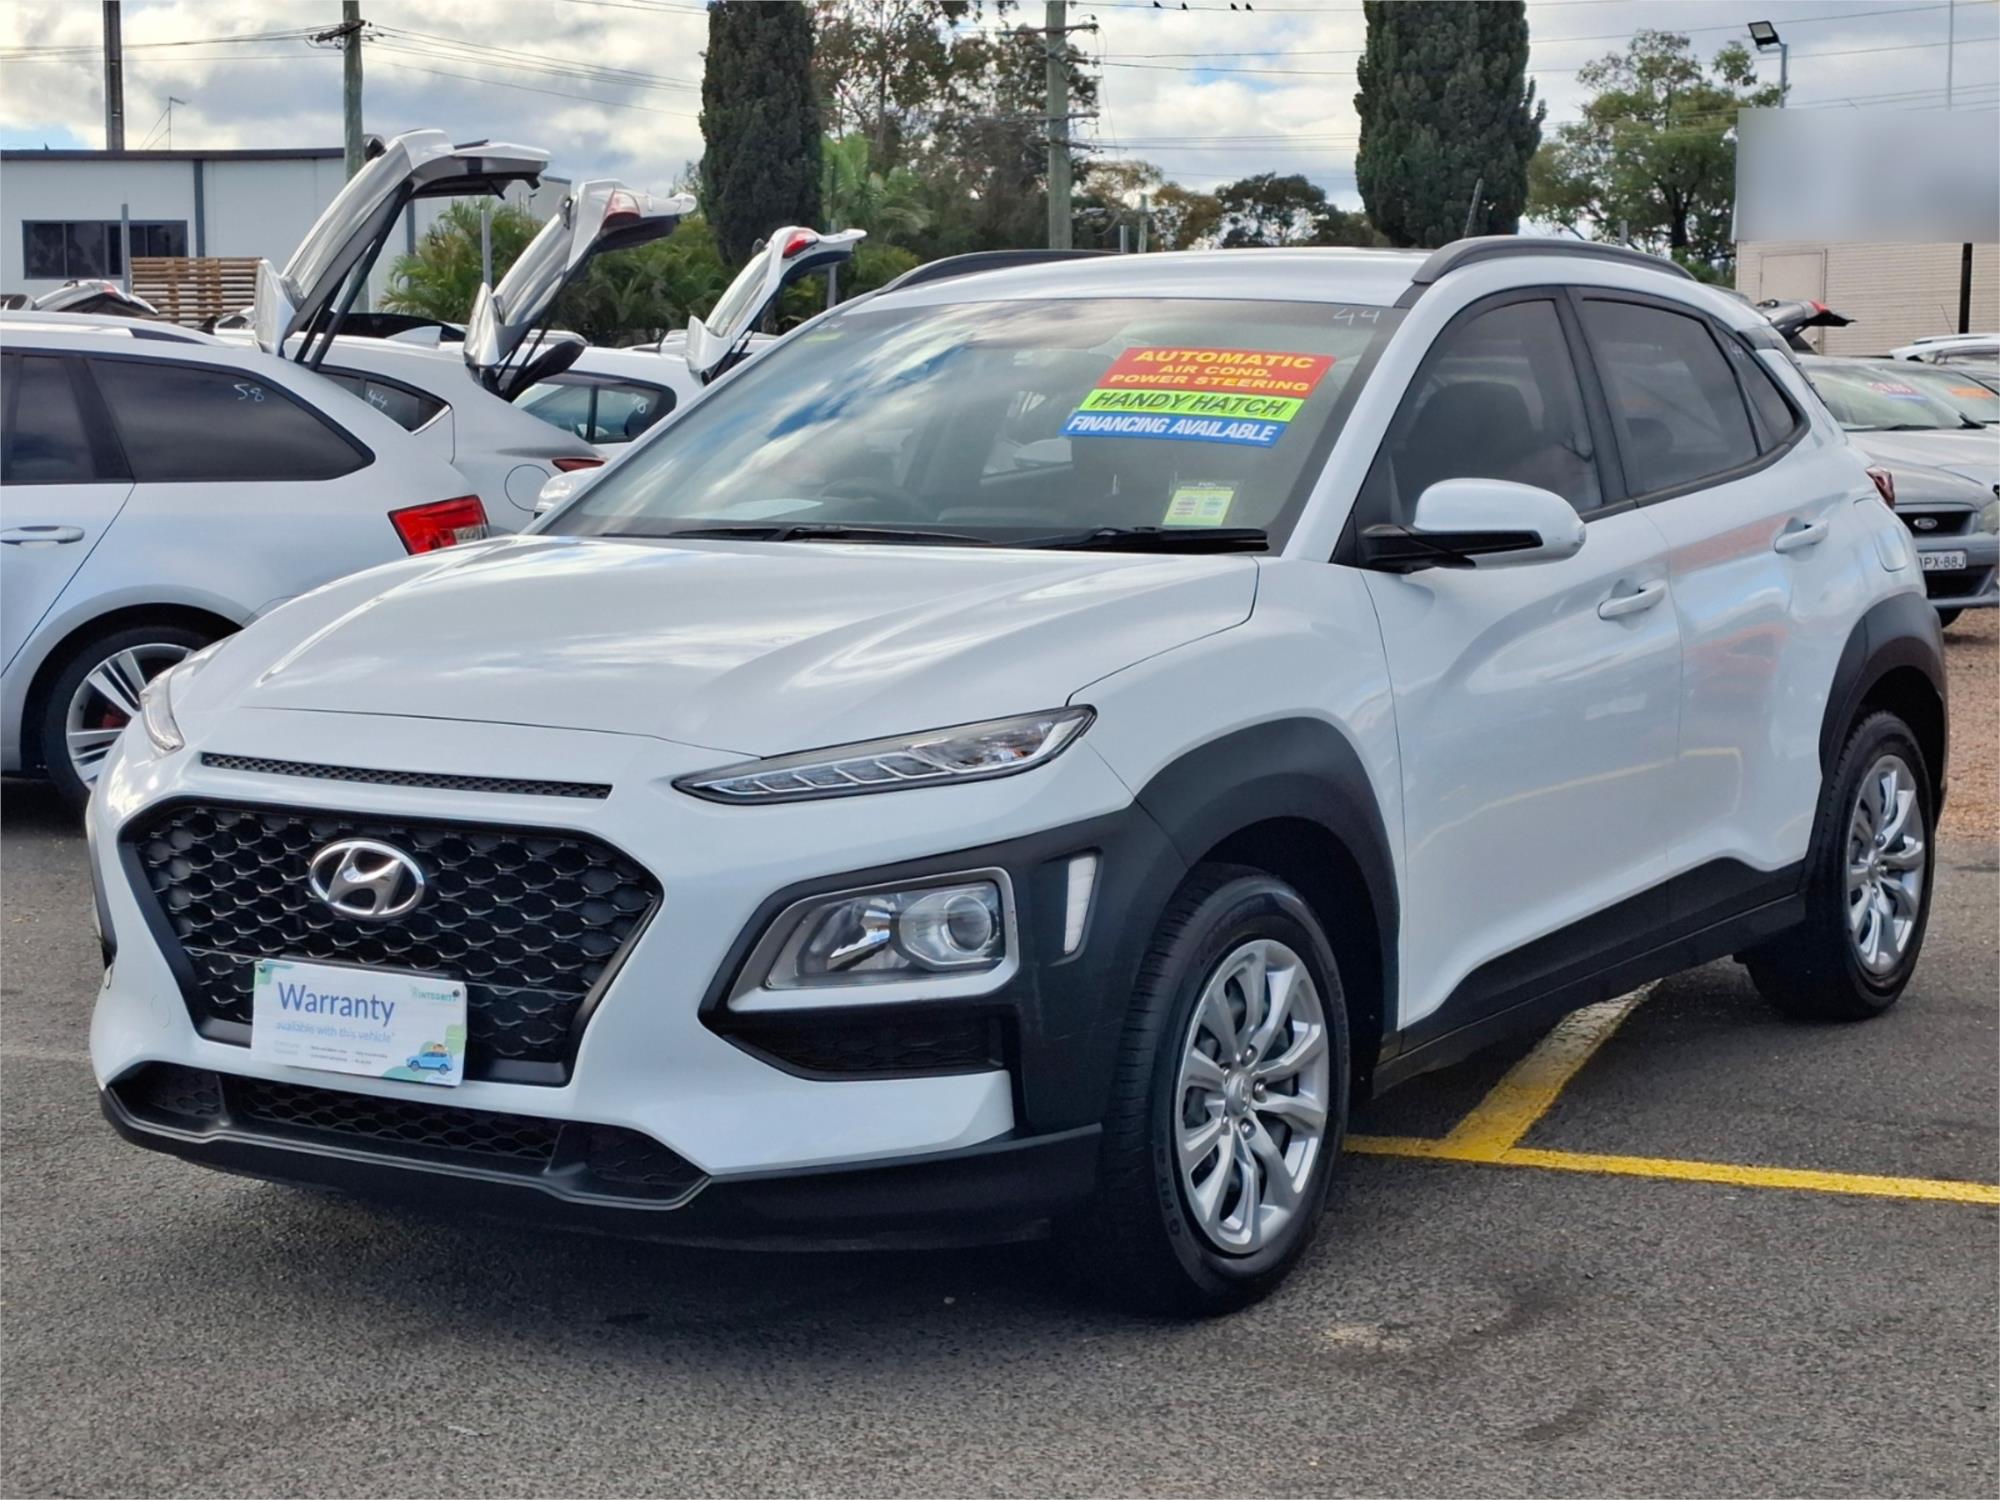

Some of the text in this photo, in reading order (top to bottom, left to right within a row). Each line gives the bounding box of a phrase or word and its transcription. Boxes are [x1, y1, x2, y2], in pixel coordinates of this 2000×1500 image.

[1333, 308, 1381, 326] 44
[1133, 350, 1316, 369] AUTOMATIC
[1159, 364, 1272, 378] AIR COND.
[233, 383, 265, 402] 58
[1109, 374, 1311, 392] POWER STEERING
[1090, 392, 1290, 416] HANDY HATCH
[1067, 415, 1277, 442] FINANCING AVAILABLE
[278, 981, 395, 1028] Warranty
[317, 1024, 337, 1036] with
